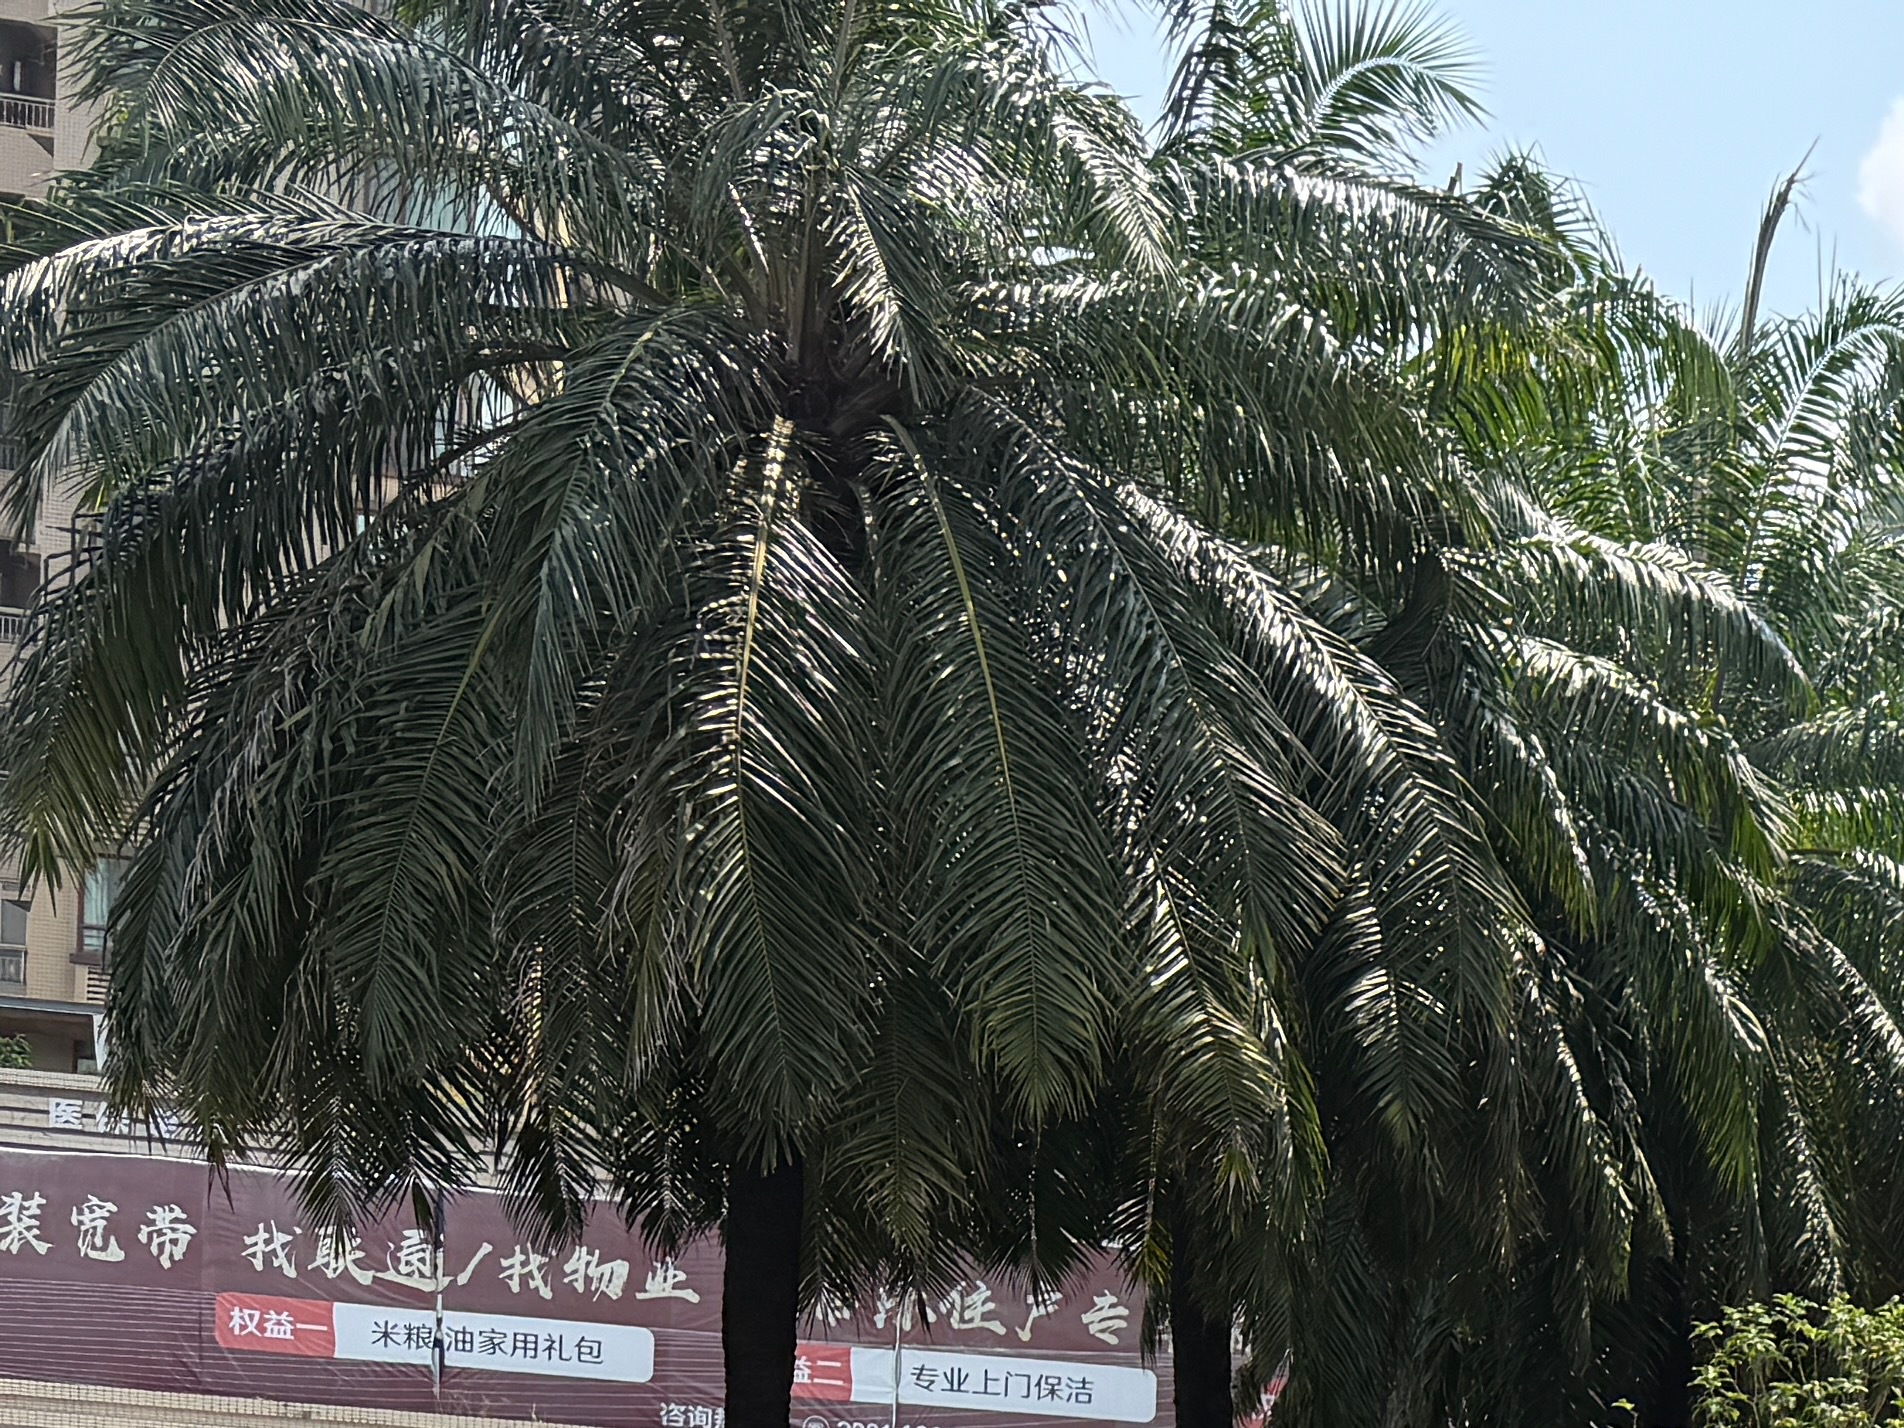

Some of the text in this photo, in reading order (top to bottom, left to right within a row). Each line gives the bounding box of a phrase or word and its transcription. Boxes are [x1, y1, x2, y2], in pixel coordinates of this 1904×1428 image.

[0, 1190, 198, 1270] 装宽带
[228, 1305, 604, 1364] 权益一 米粮油家用礼包
[910, 1363, 1095, 1405] 专业上门保洁
